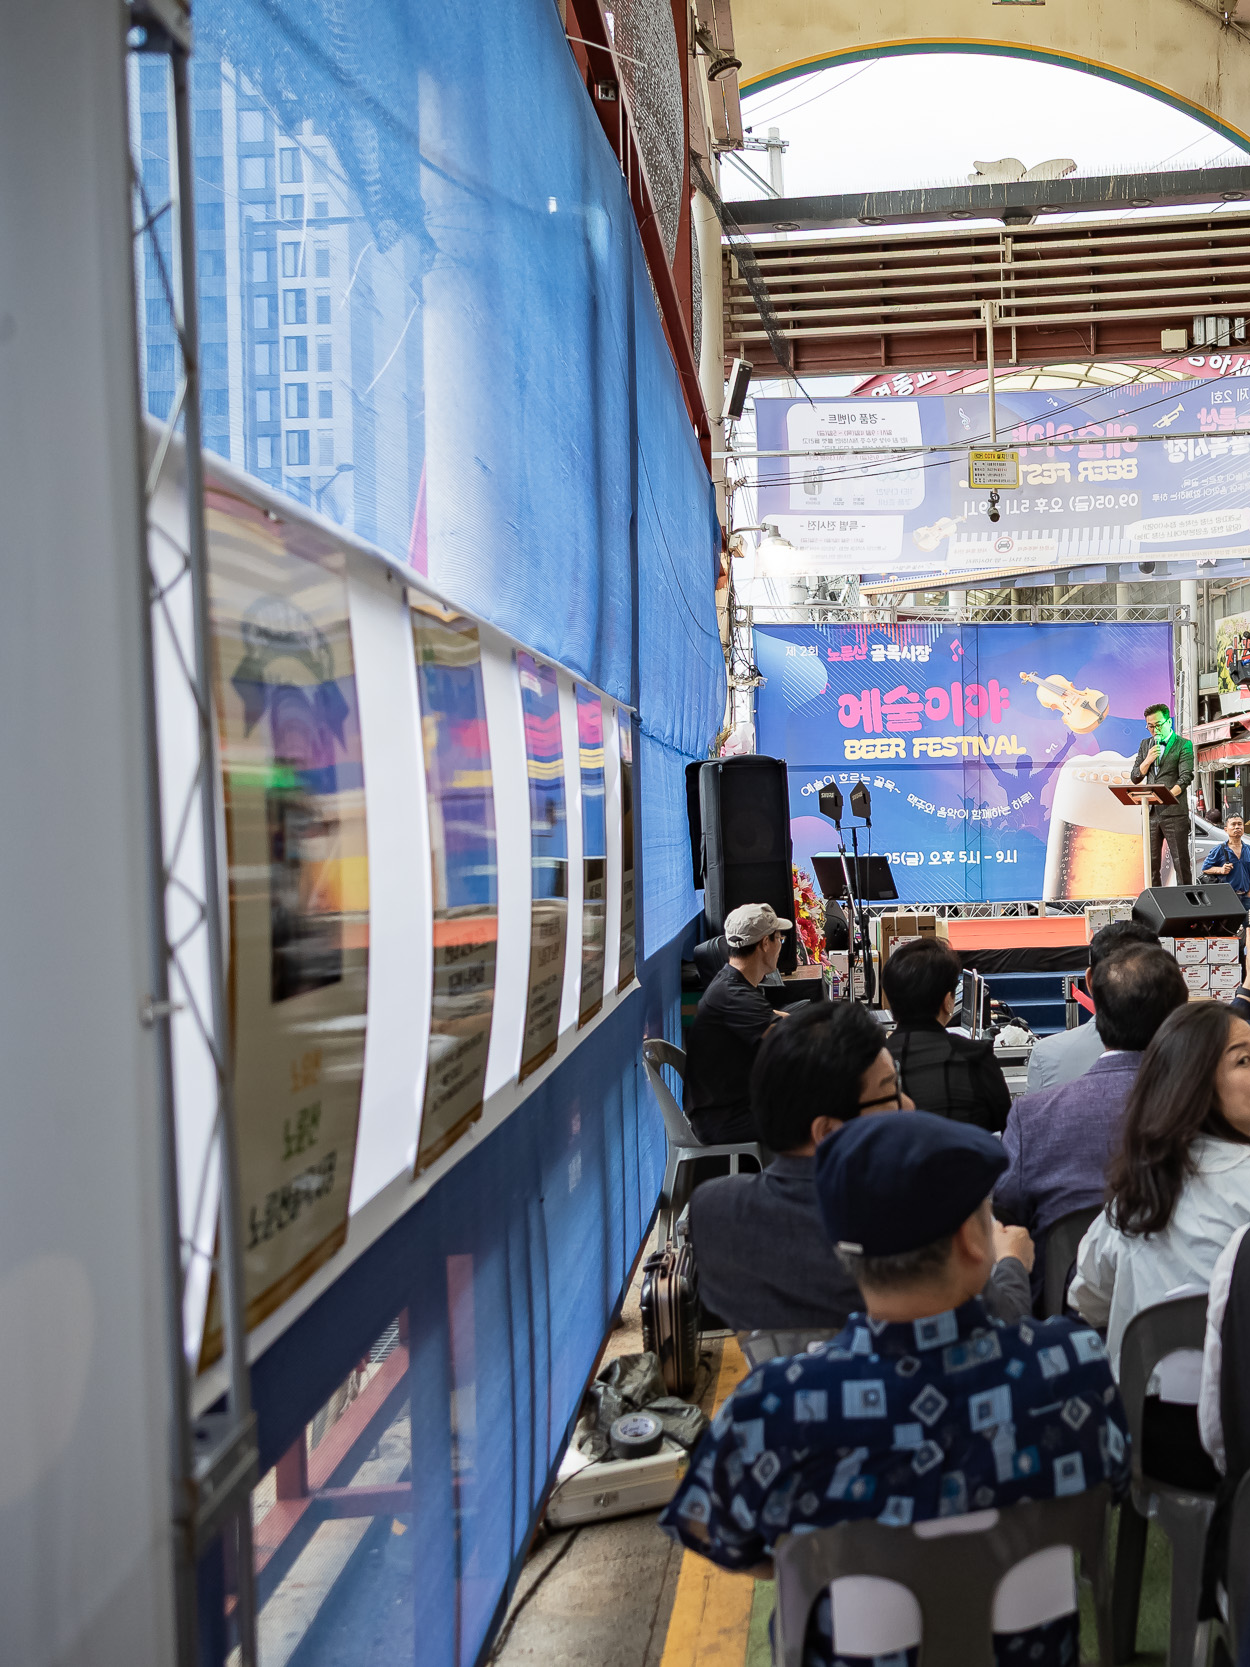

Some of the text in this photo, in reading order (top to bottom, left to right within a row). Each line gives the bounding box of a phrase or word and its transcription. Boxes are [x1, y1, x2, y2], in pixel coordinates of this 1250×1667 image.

[785, 644, 796, 657] 제
[799, 644, 819, 657] 2회
[870, 644, 933, 662] 골목시장
[837, 679, 1010, 734] 예술이야
[843, 734, 1027, 760] BEER FESTIVAL
[838, 772, 871, 785] 흐르는
[906, 791, 1035, 820] 맥주와 음악이 함께하는 하루!
[927, 850, 956, 866] 오후
[958, 850, 980, 864] 5시
[995, 849, 1018, 864] 9시
